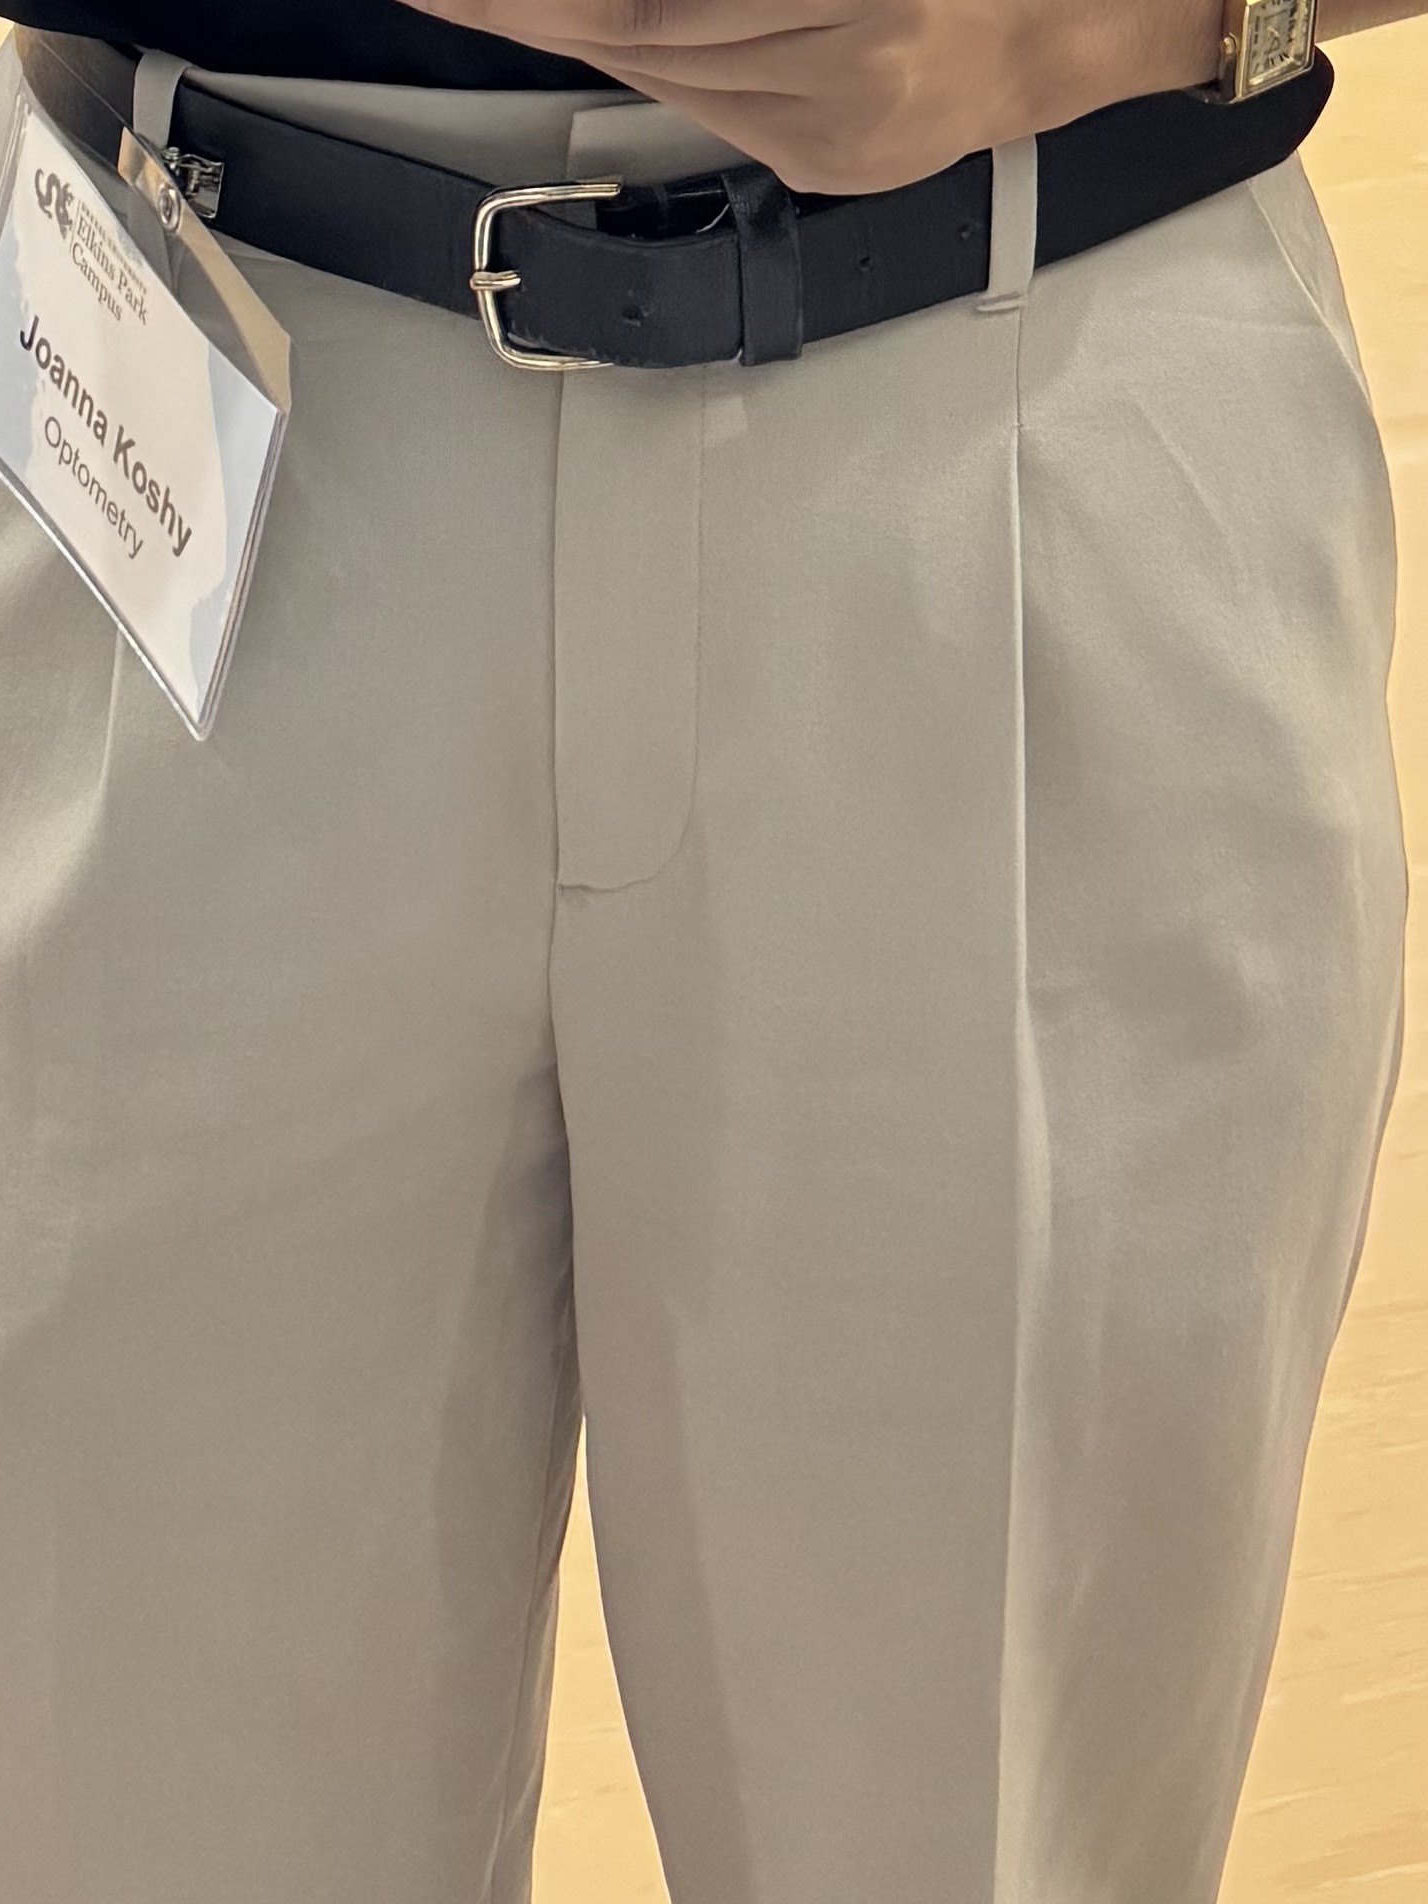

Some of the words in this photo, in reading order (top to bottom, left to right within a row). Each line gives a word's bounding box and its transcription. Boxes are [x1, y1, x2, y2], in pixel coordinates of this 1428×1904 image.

[72, 241, 123, 322] Campus
[76, 213, 116, 281] Elkins
[117, 268, 148, 325] Park
[19, 314, 109, 448] Joanna
[112, 424, 193, 558] Koshy
[44, 415, 144, 560] Optometry
